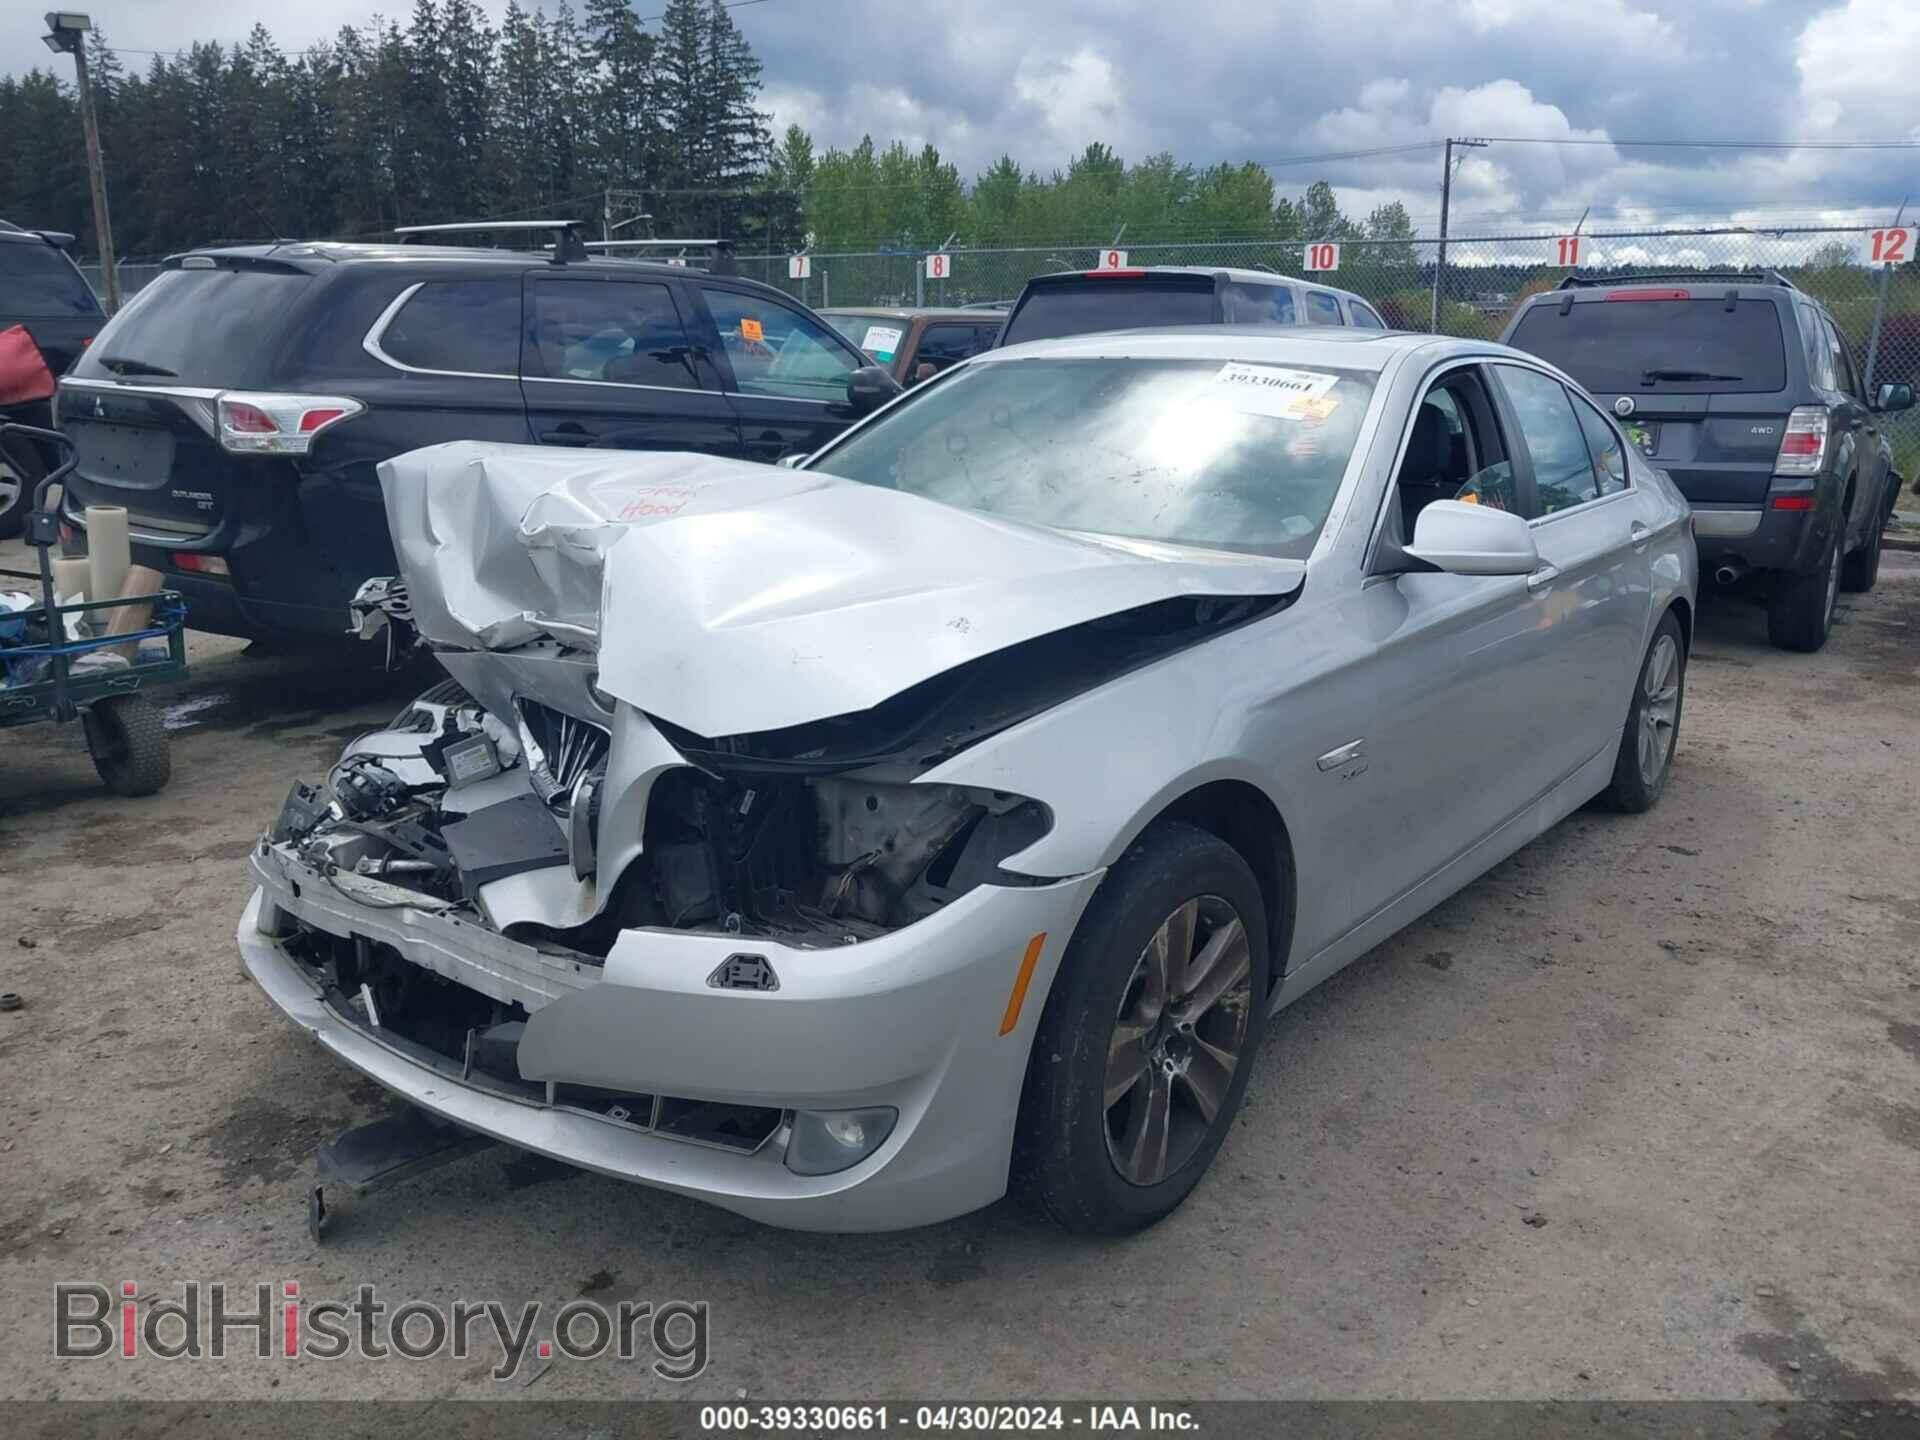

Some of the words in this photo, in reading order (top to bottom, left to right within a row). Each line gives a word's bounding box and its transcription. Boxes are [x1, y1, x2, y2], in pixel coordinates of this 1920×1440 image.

[1557, 238, 1578, 266] 11
[1871, 230, 1908, 261] 12
[932, 256, 944, 277] 8
[1107, 252, 1118, 270] 9
[1310, 245, 1334, 269] 10
[795, 258, 805, 278] 7
[1223, 373, 1314, 392] 39330661
[1750, 426, 1774, 435] 4WD
